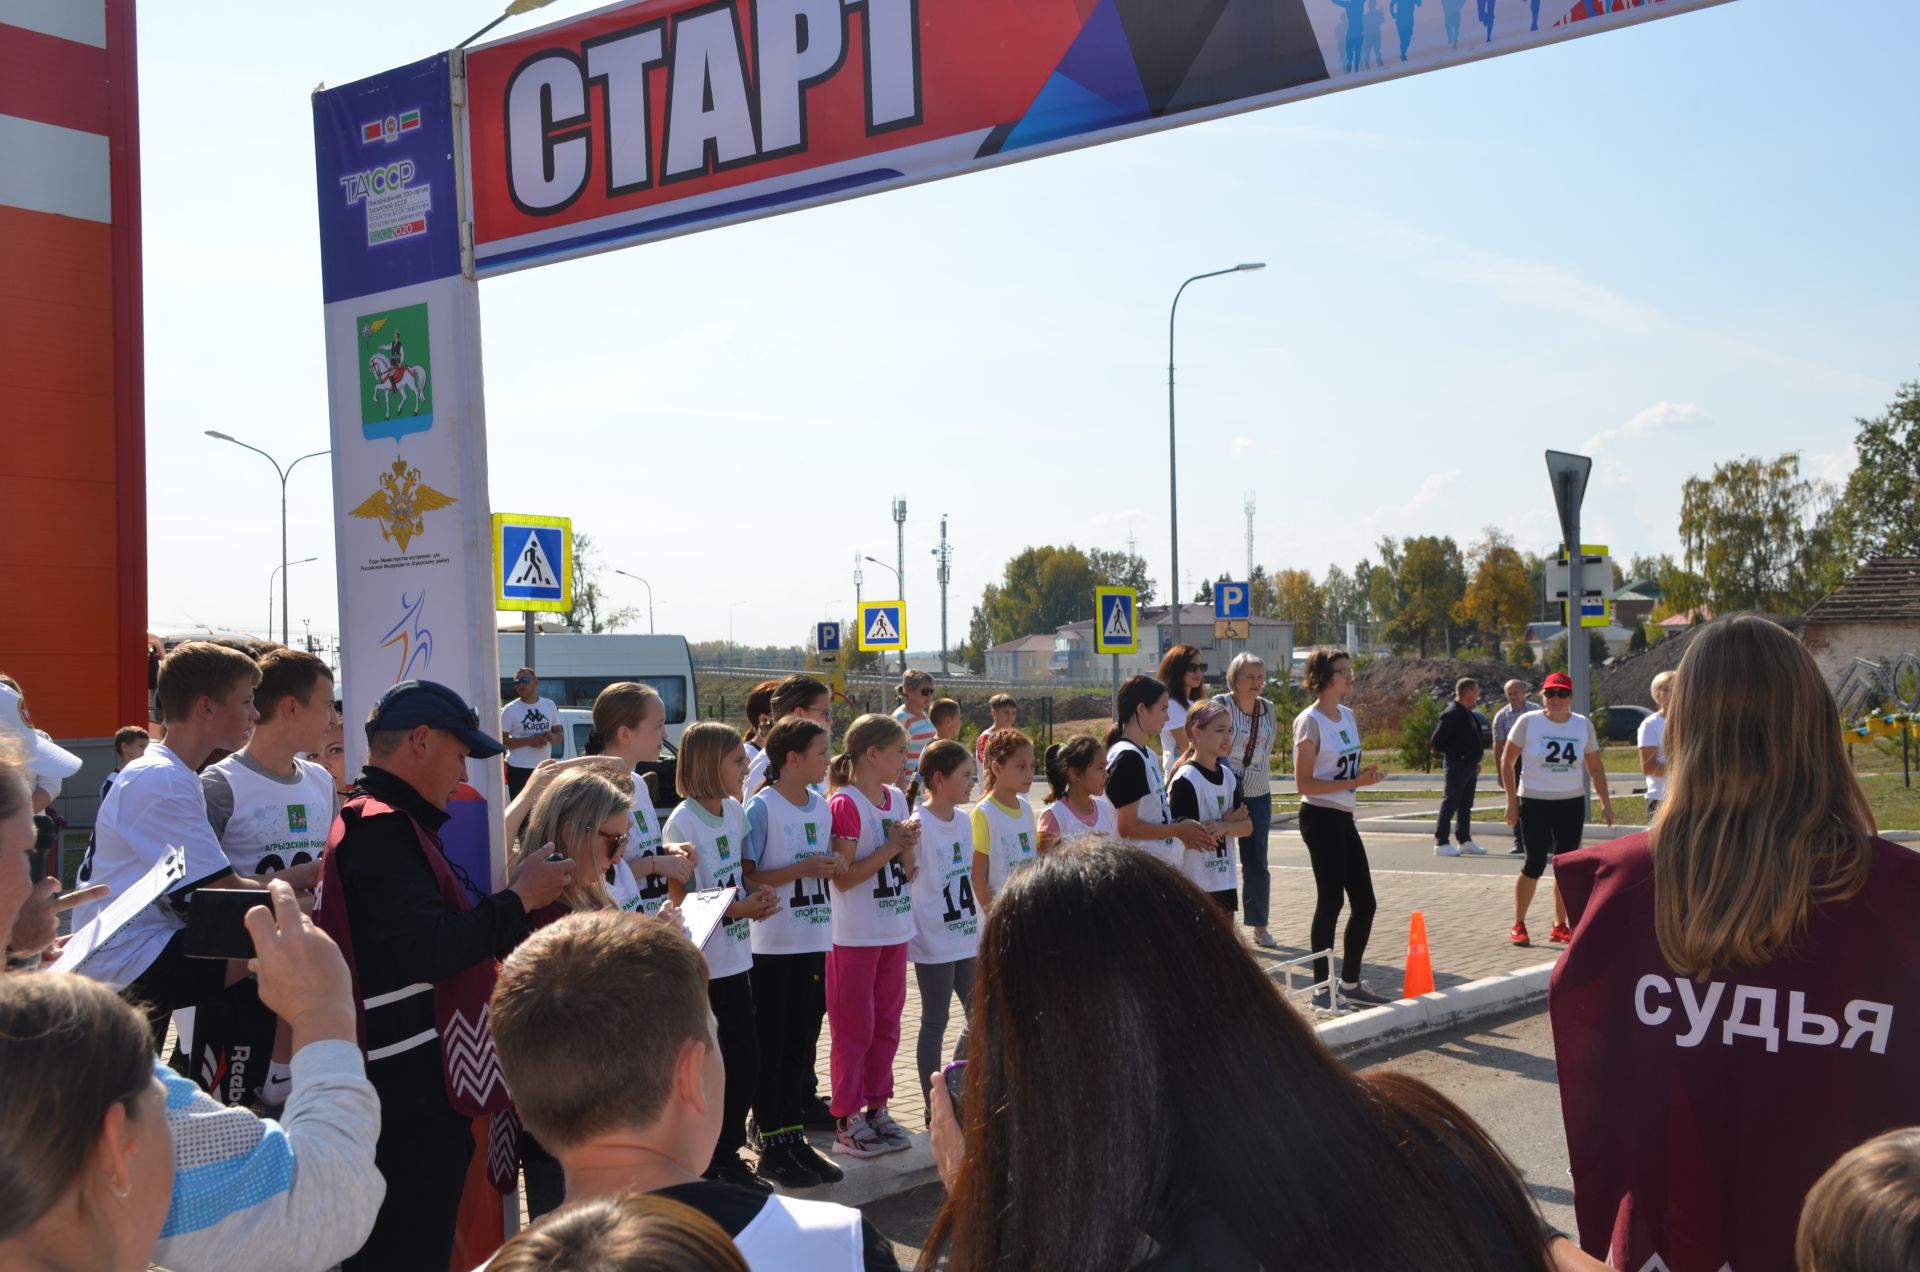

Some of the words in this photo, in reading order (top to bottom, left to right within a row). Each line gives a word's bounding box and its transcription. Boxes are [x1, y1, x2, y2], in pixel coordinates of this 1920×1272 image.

[503, 0, 923, 217] СТАРТ
[523, 721, 550, 732] Kappa
[1545, 741, 1577, 764] 24
[943, 875, 976, 923] 14
